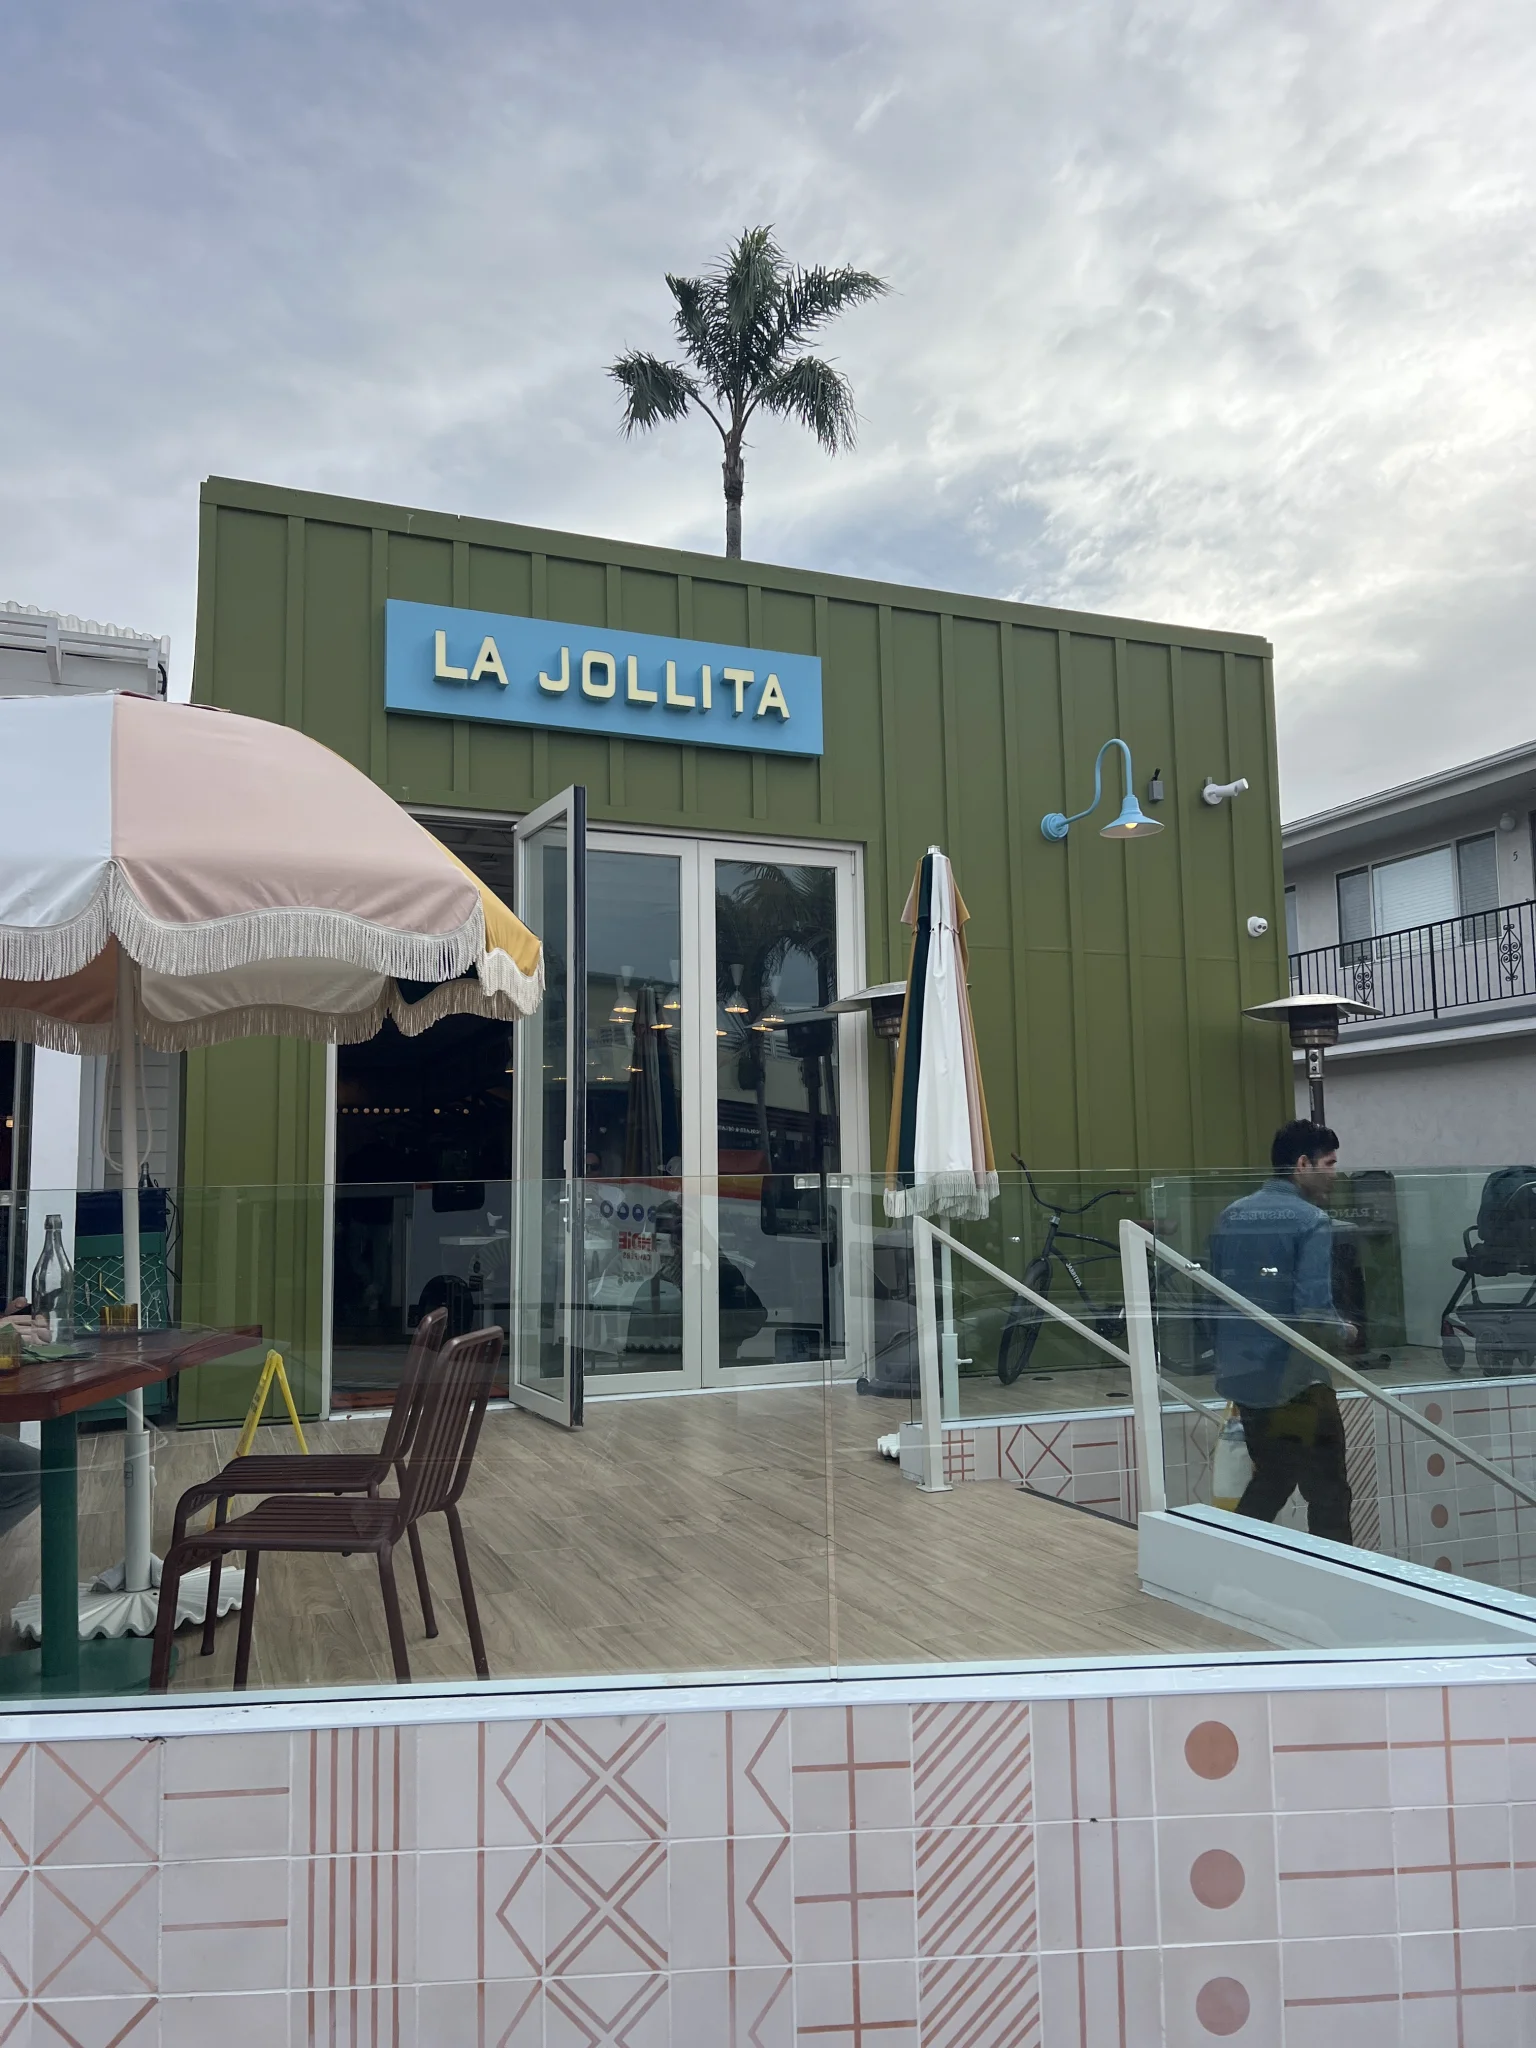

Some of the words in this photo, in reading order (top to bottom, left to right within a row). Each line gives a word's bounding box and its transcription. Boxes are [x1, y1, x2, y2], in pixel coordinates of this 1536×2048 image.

[433, 629, 509, 687] LA
[537, 646, 791, 721] JOLLITA
[1513, 850, 1519, 862] 5
[1065, 1261, 1083, 1288] JARRITOS
